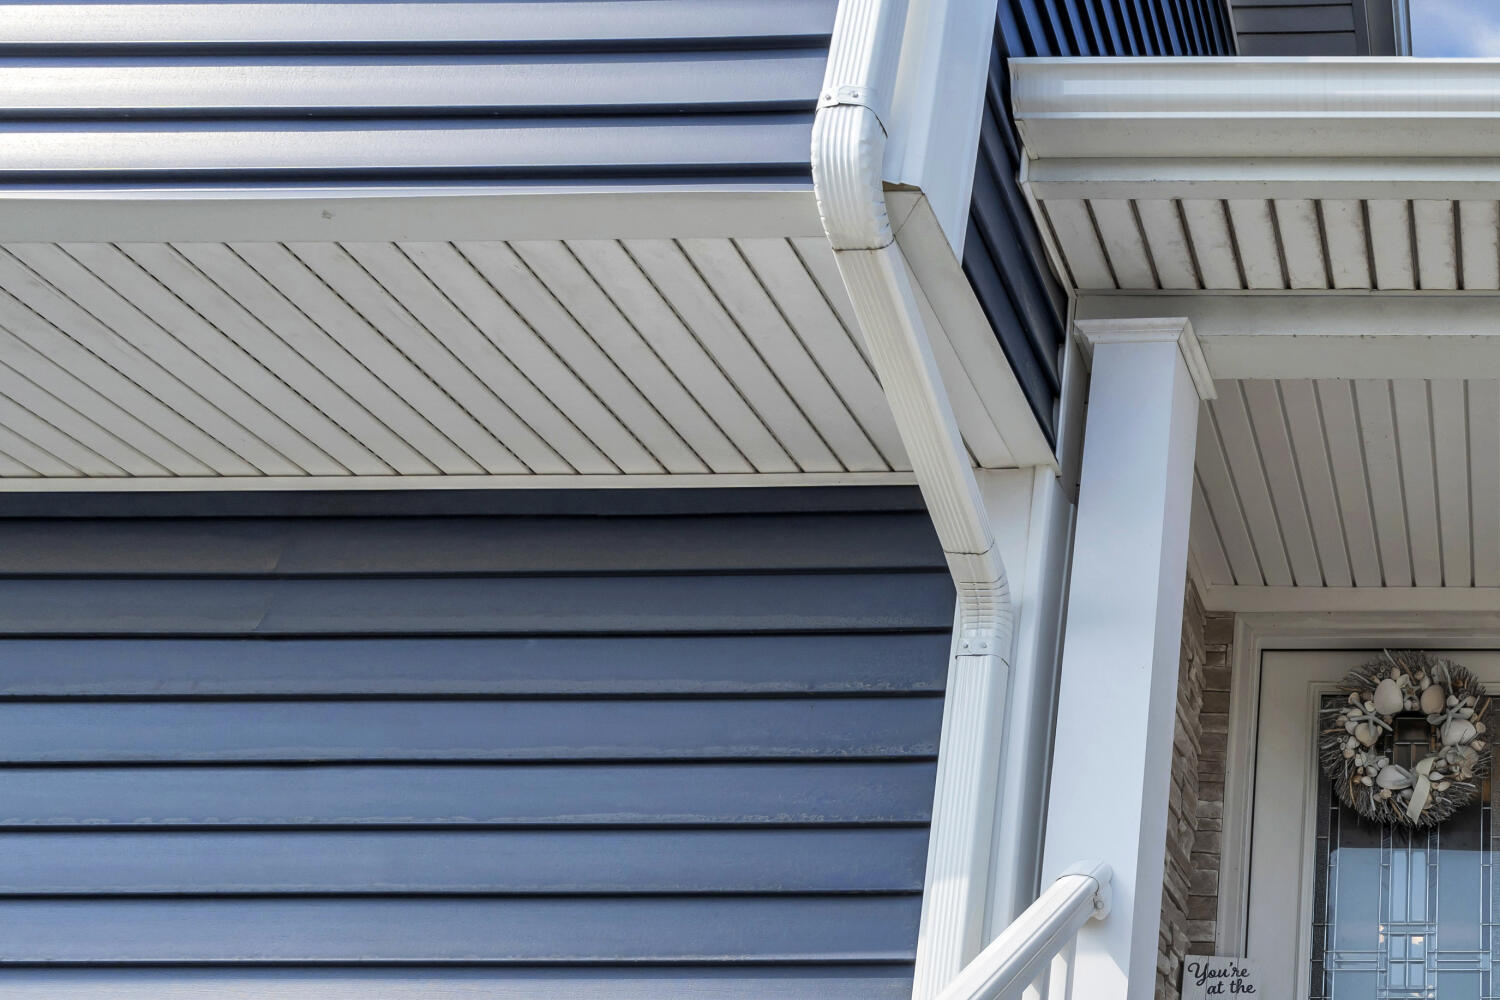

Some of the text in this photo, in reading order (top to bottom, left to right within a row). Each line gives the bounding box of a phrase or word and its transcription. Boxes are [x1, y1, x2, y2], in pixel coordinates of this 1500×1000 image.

[1187, 962, 1250, 986] You're
[1206, 978, 1257, 995] at the
